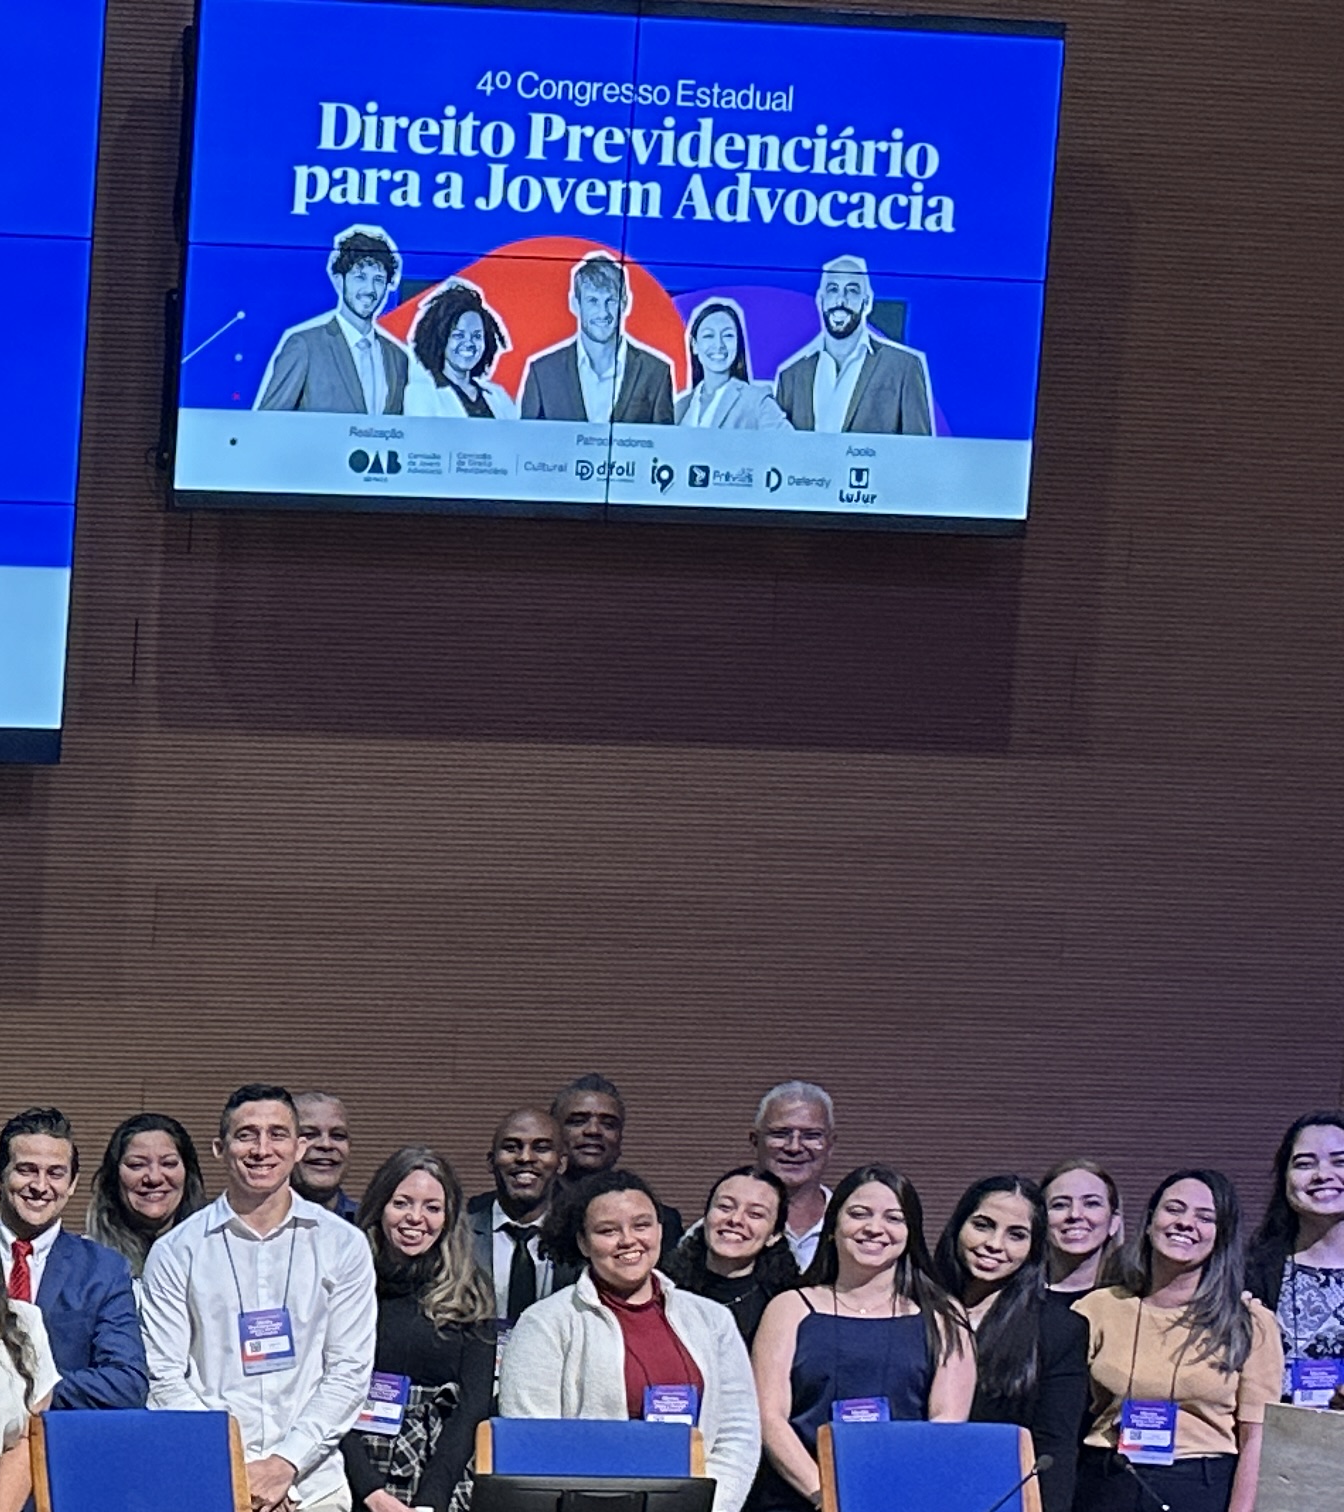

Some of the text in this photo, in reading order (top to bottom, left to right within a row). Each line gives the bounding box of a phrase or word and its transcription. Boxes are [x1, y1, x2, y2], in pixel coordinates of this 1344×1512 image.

[475, 71, 795, 113] 4º Congresso Estadual
[316, 101, 941, 180] Direito Previdenciário
[291, 164, 957, 233] para a Jovem Advocacia
